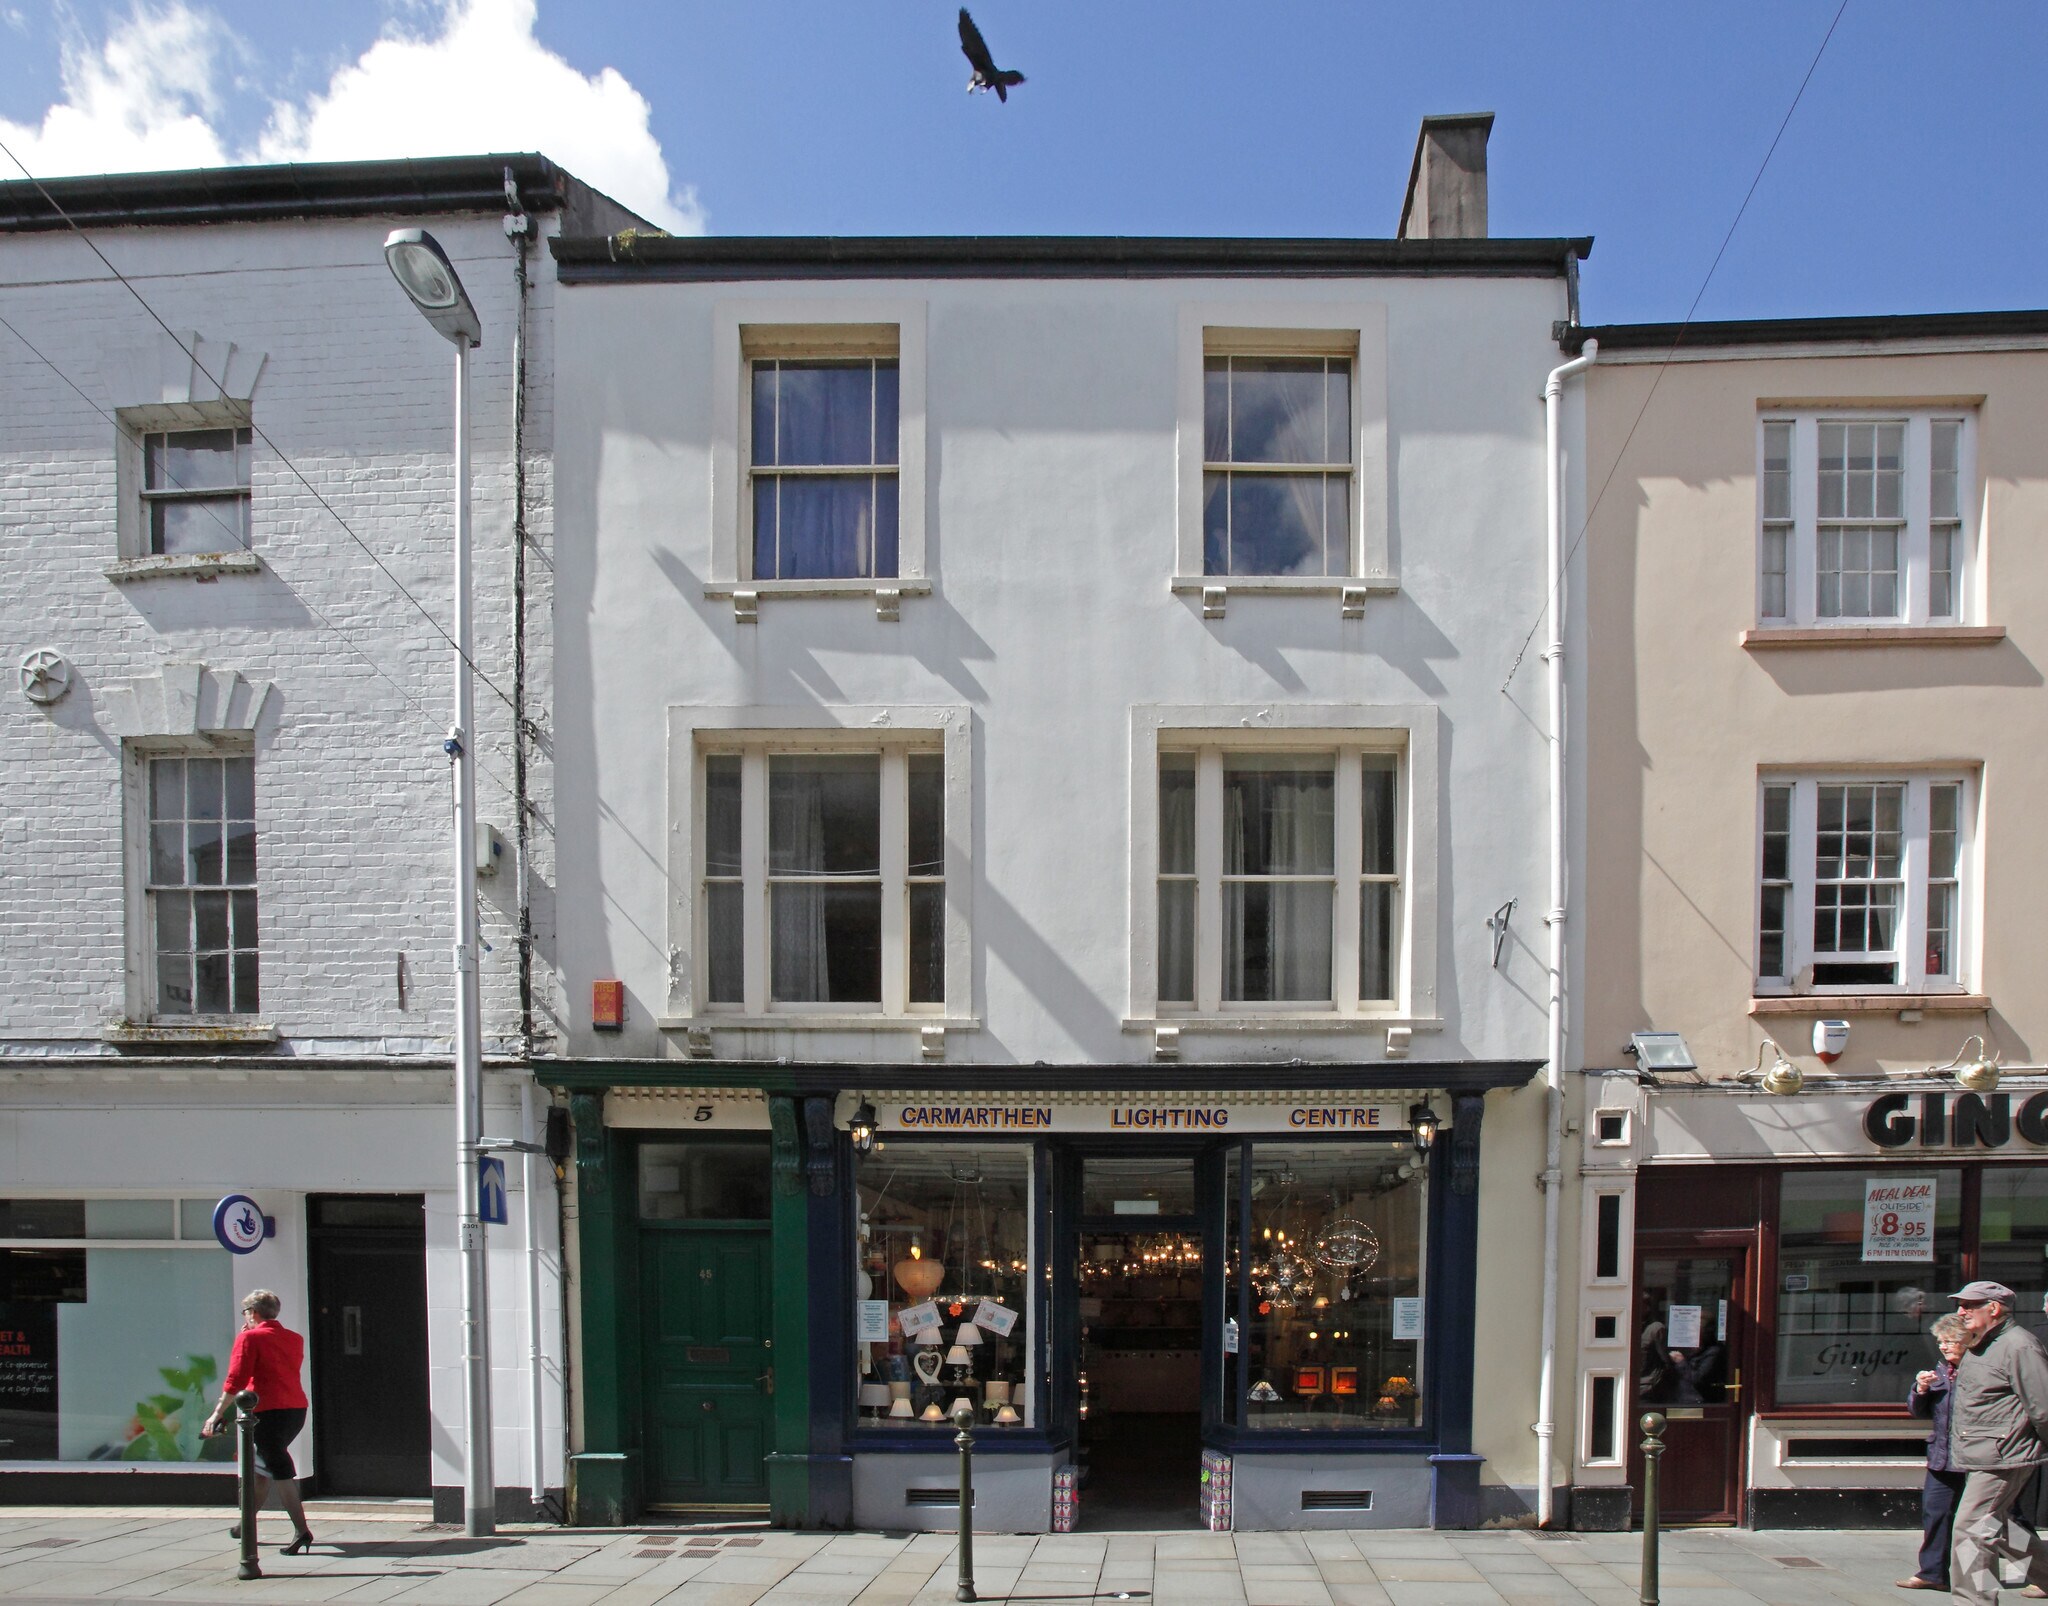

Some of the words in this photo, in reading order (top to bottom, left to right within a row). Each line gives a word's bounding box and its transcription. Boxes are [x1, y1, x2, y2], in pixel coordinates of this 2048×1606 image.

[694, 1105, 714, 1122] 5
[900, 1107, 1052, 1128] CARMARTHEN
[1111, 1108, 1229, 1129] LIGHTING
[1289, 1108, 1380, 1128] CENTRE
[1868, 1187, 1900, 1201] MEAL
[1902, 1185, 1931, 1198] DEAL
[1813, 1343, 1909, 1377] Ginger
